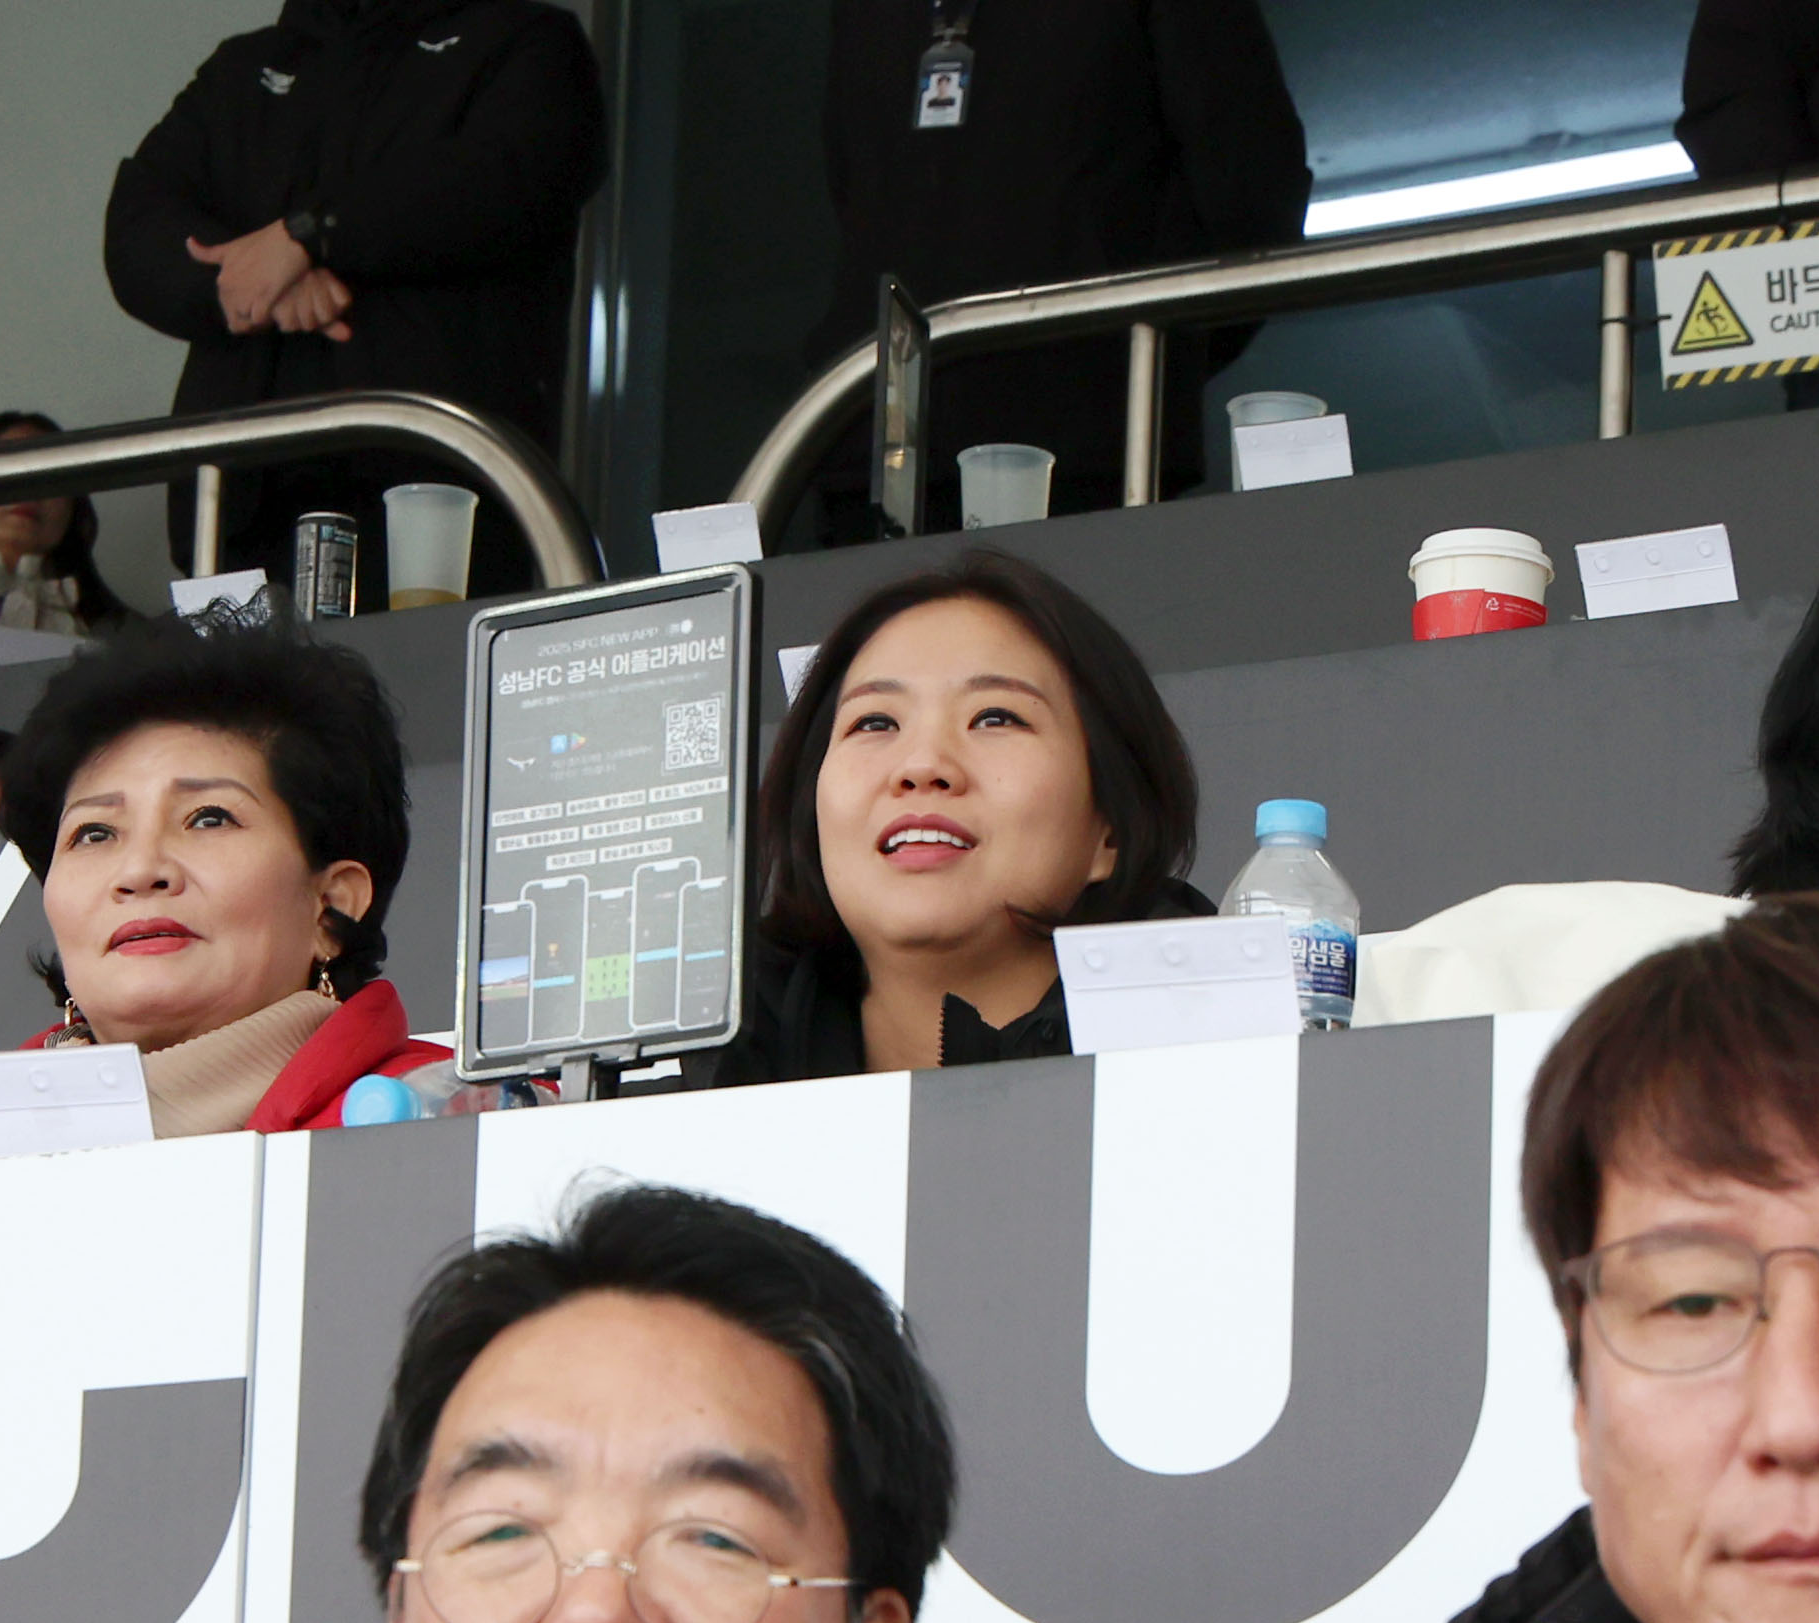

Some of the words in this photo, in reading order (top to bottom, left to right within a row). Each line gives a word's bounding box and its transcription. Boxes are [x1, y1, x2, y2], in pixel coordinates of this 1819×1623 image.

[498, 666, 563, 696] 성남FC
[566, 658, 606, 683] 공식
[611, 636, 727, 676] 어플리케이션
